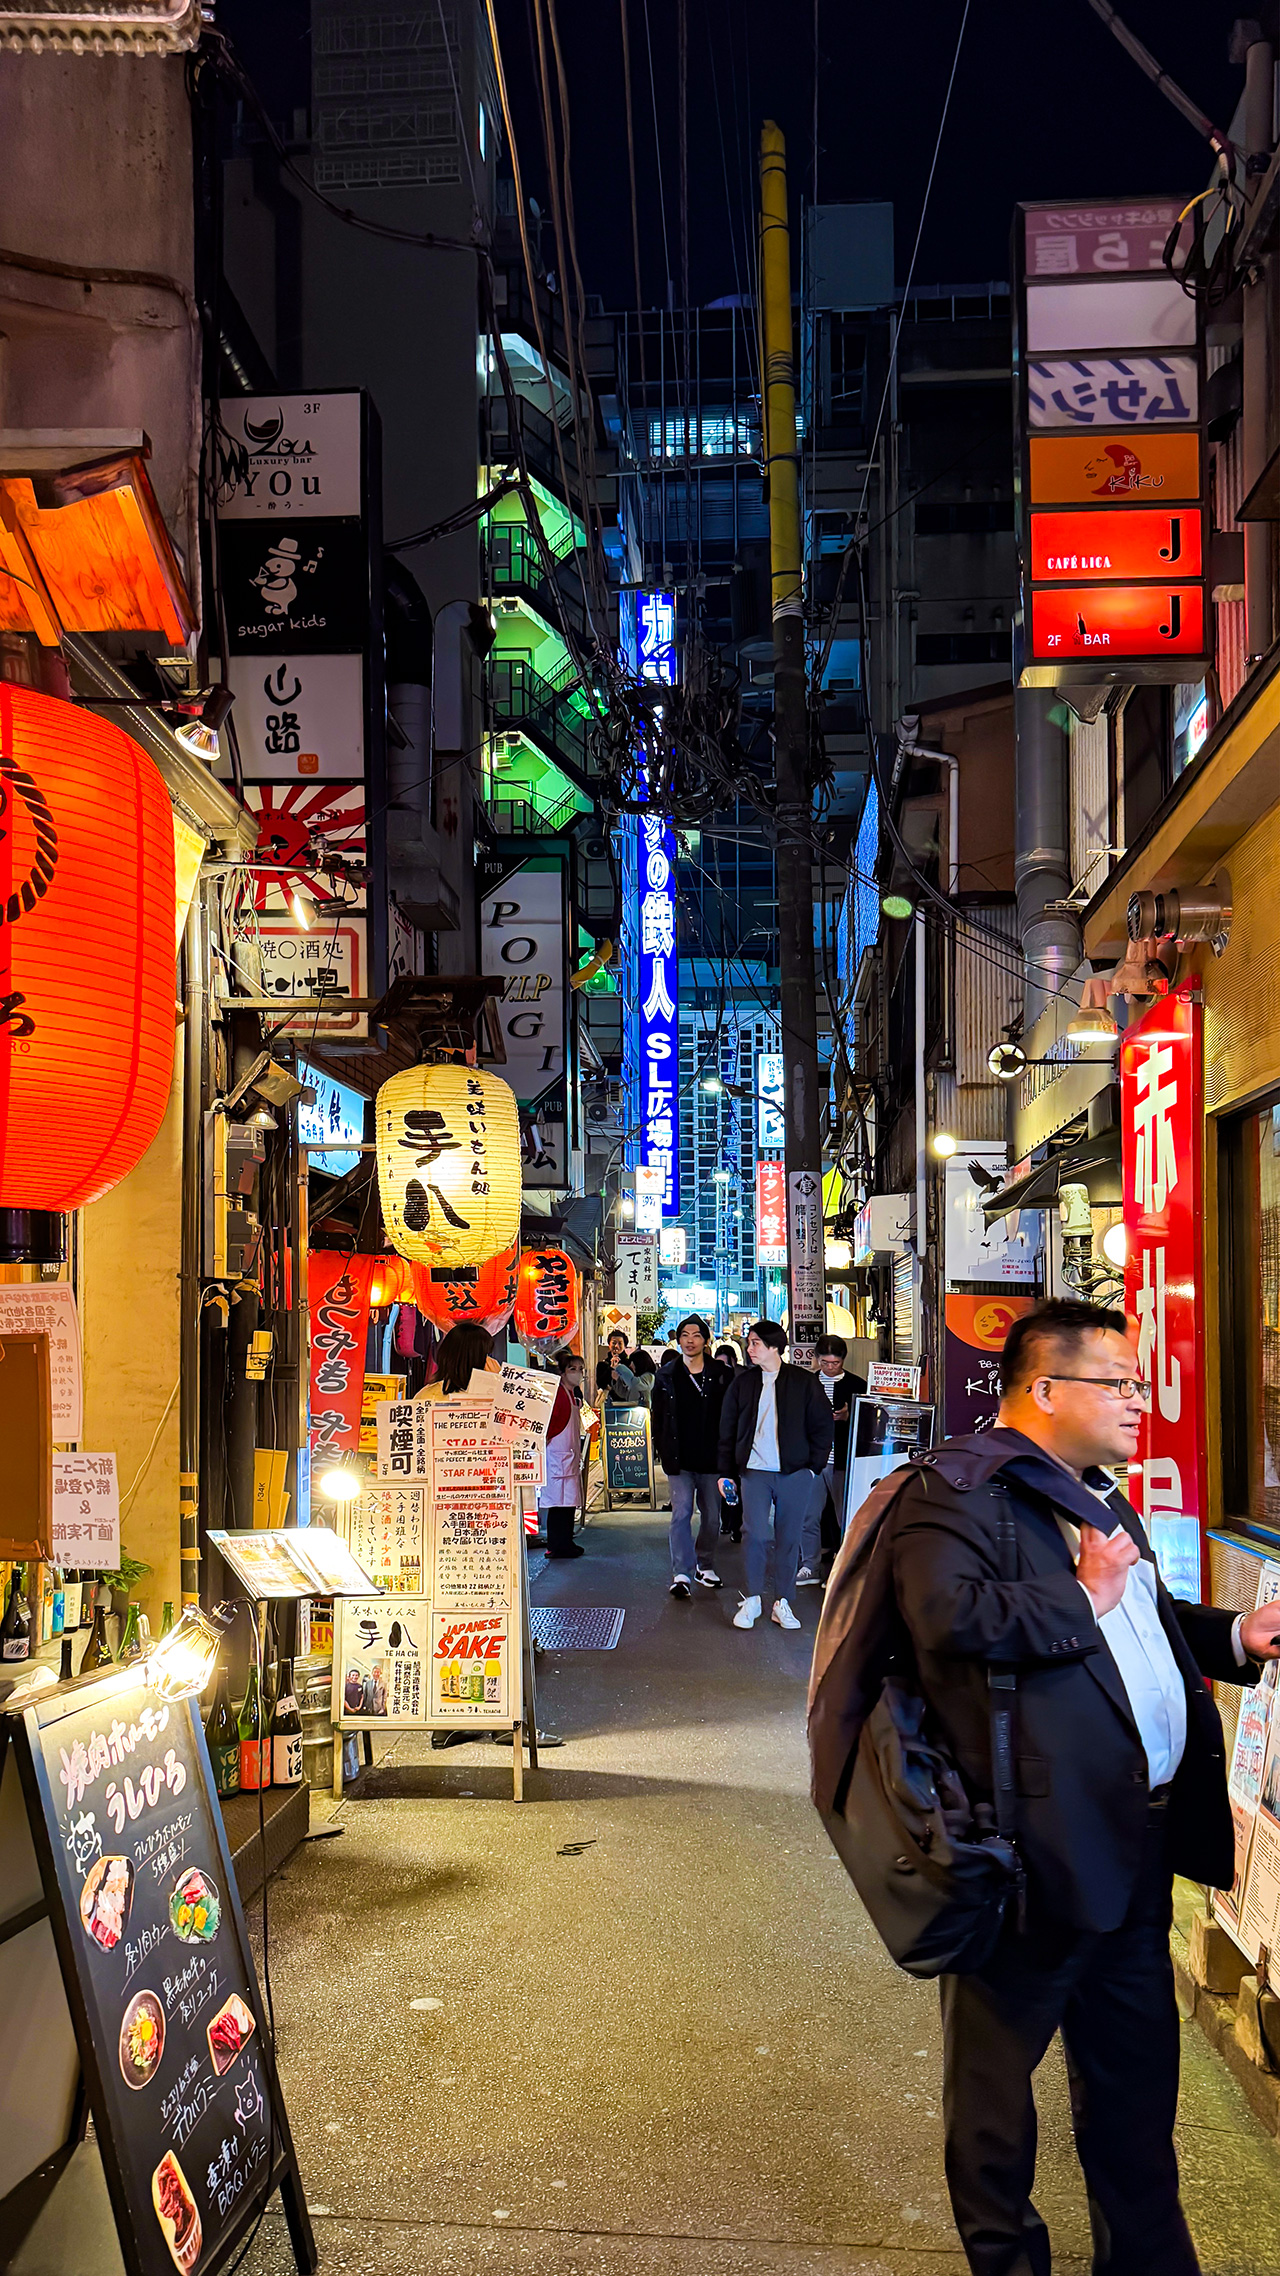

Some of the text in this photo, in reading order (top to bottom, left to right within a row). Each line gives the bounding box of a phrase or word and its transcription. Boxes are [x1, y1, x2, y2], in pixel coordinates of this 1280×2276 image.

[303, 402, 321, 414] 3F
[249, 456, 312, 466] Luxury bar
[1047, 555, 1112, 570] CAFÉ LICA
[238, 615, 327, 638] sugar kids
[1047, 633, 1111, 646] 2F BAR
[264, 662, 303, 755] 山路
[484, 862, 503, 874] PUB
[544, 1101, 563, 1112] PUB
[466, 1079, 491, 1195] 美味いもん処
[760, 1163, 782, 1244] 牛タン・餃子
[810, 1204, 818, 1254] コンセプトは
[643, 1247, 652, 1282] 家庭料理
[626, 1251, 642, 1305] てまり
[515, 1400, 526, 1411] &
[450, 1421, 477, 1429] PEFECT
[493, 1412, 544, 1434] 値下実施
[389, 1405, 413, 1475] 喫煙可
[395, 1491, 407, 1549] 入手困難な
[410, 1491, 421, 1546] 週替わりで
[441, 1520, 509, 1529] 入手困難で希少な
[449, 1512, 499, 1521] 全国各地から
[454, 1529, 487, 1537] 日本酒が
[351, 1606, 417, 1616] 美味いもん処
[487, 1597, 509, 1608] 手八
[443, 1617, 502, 1637] JAPANESE
[433, 1635, 507, 1659] SAKE
[105, 1748, 188, 1835] うしひろ
[151, 1837, 186, 1879] 5種盛り
[161, 1955, 208, 2010] 黒毛和牛の
